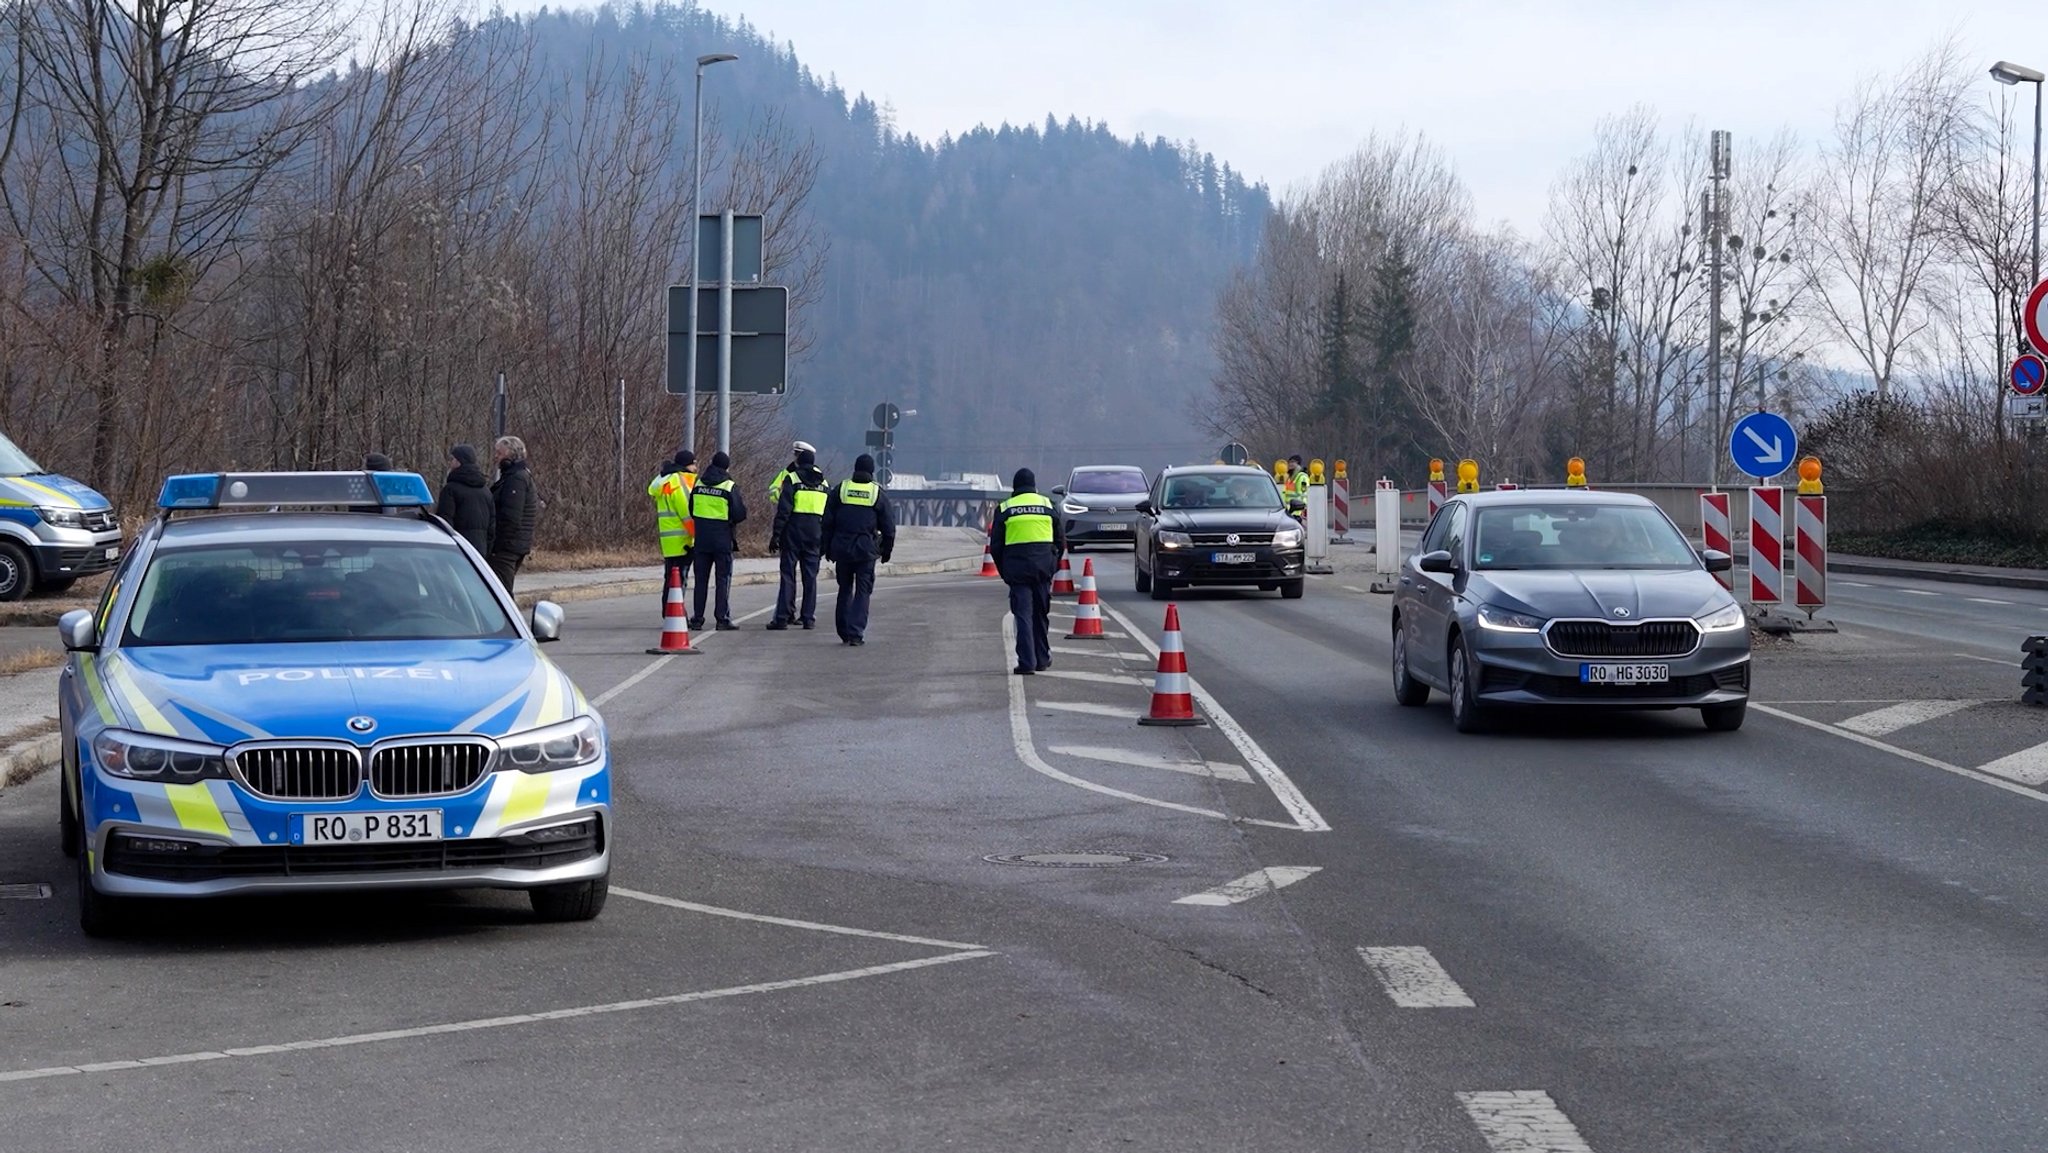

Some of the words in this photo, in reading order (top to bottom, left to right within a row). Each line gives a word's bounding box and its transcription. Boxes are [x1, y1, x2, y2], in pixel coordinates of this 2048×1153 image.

[697, 487, 723, 496] POLIZEI
[848, 490, 871, 499] POLIZEI
[1010, 507, 1045, 515] POLIZEI
[239, 667, 454, 686] POLIZEI
[1590, 666, 1606, 680] RO
[1616, 666, 1633, 680] HG
[1635, 665, 1667, 680] 3030
[314, 816, 347, 841] RO
[364, 815, 381, 839] P
[387, 814, 432, 838] 831
